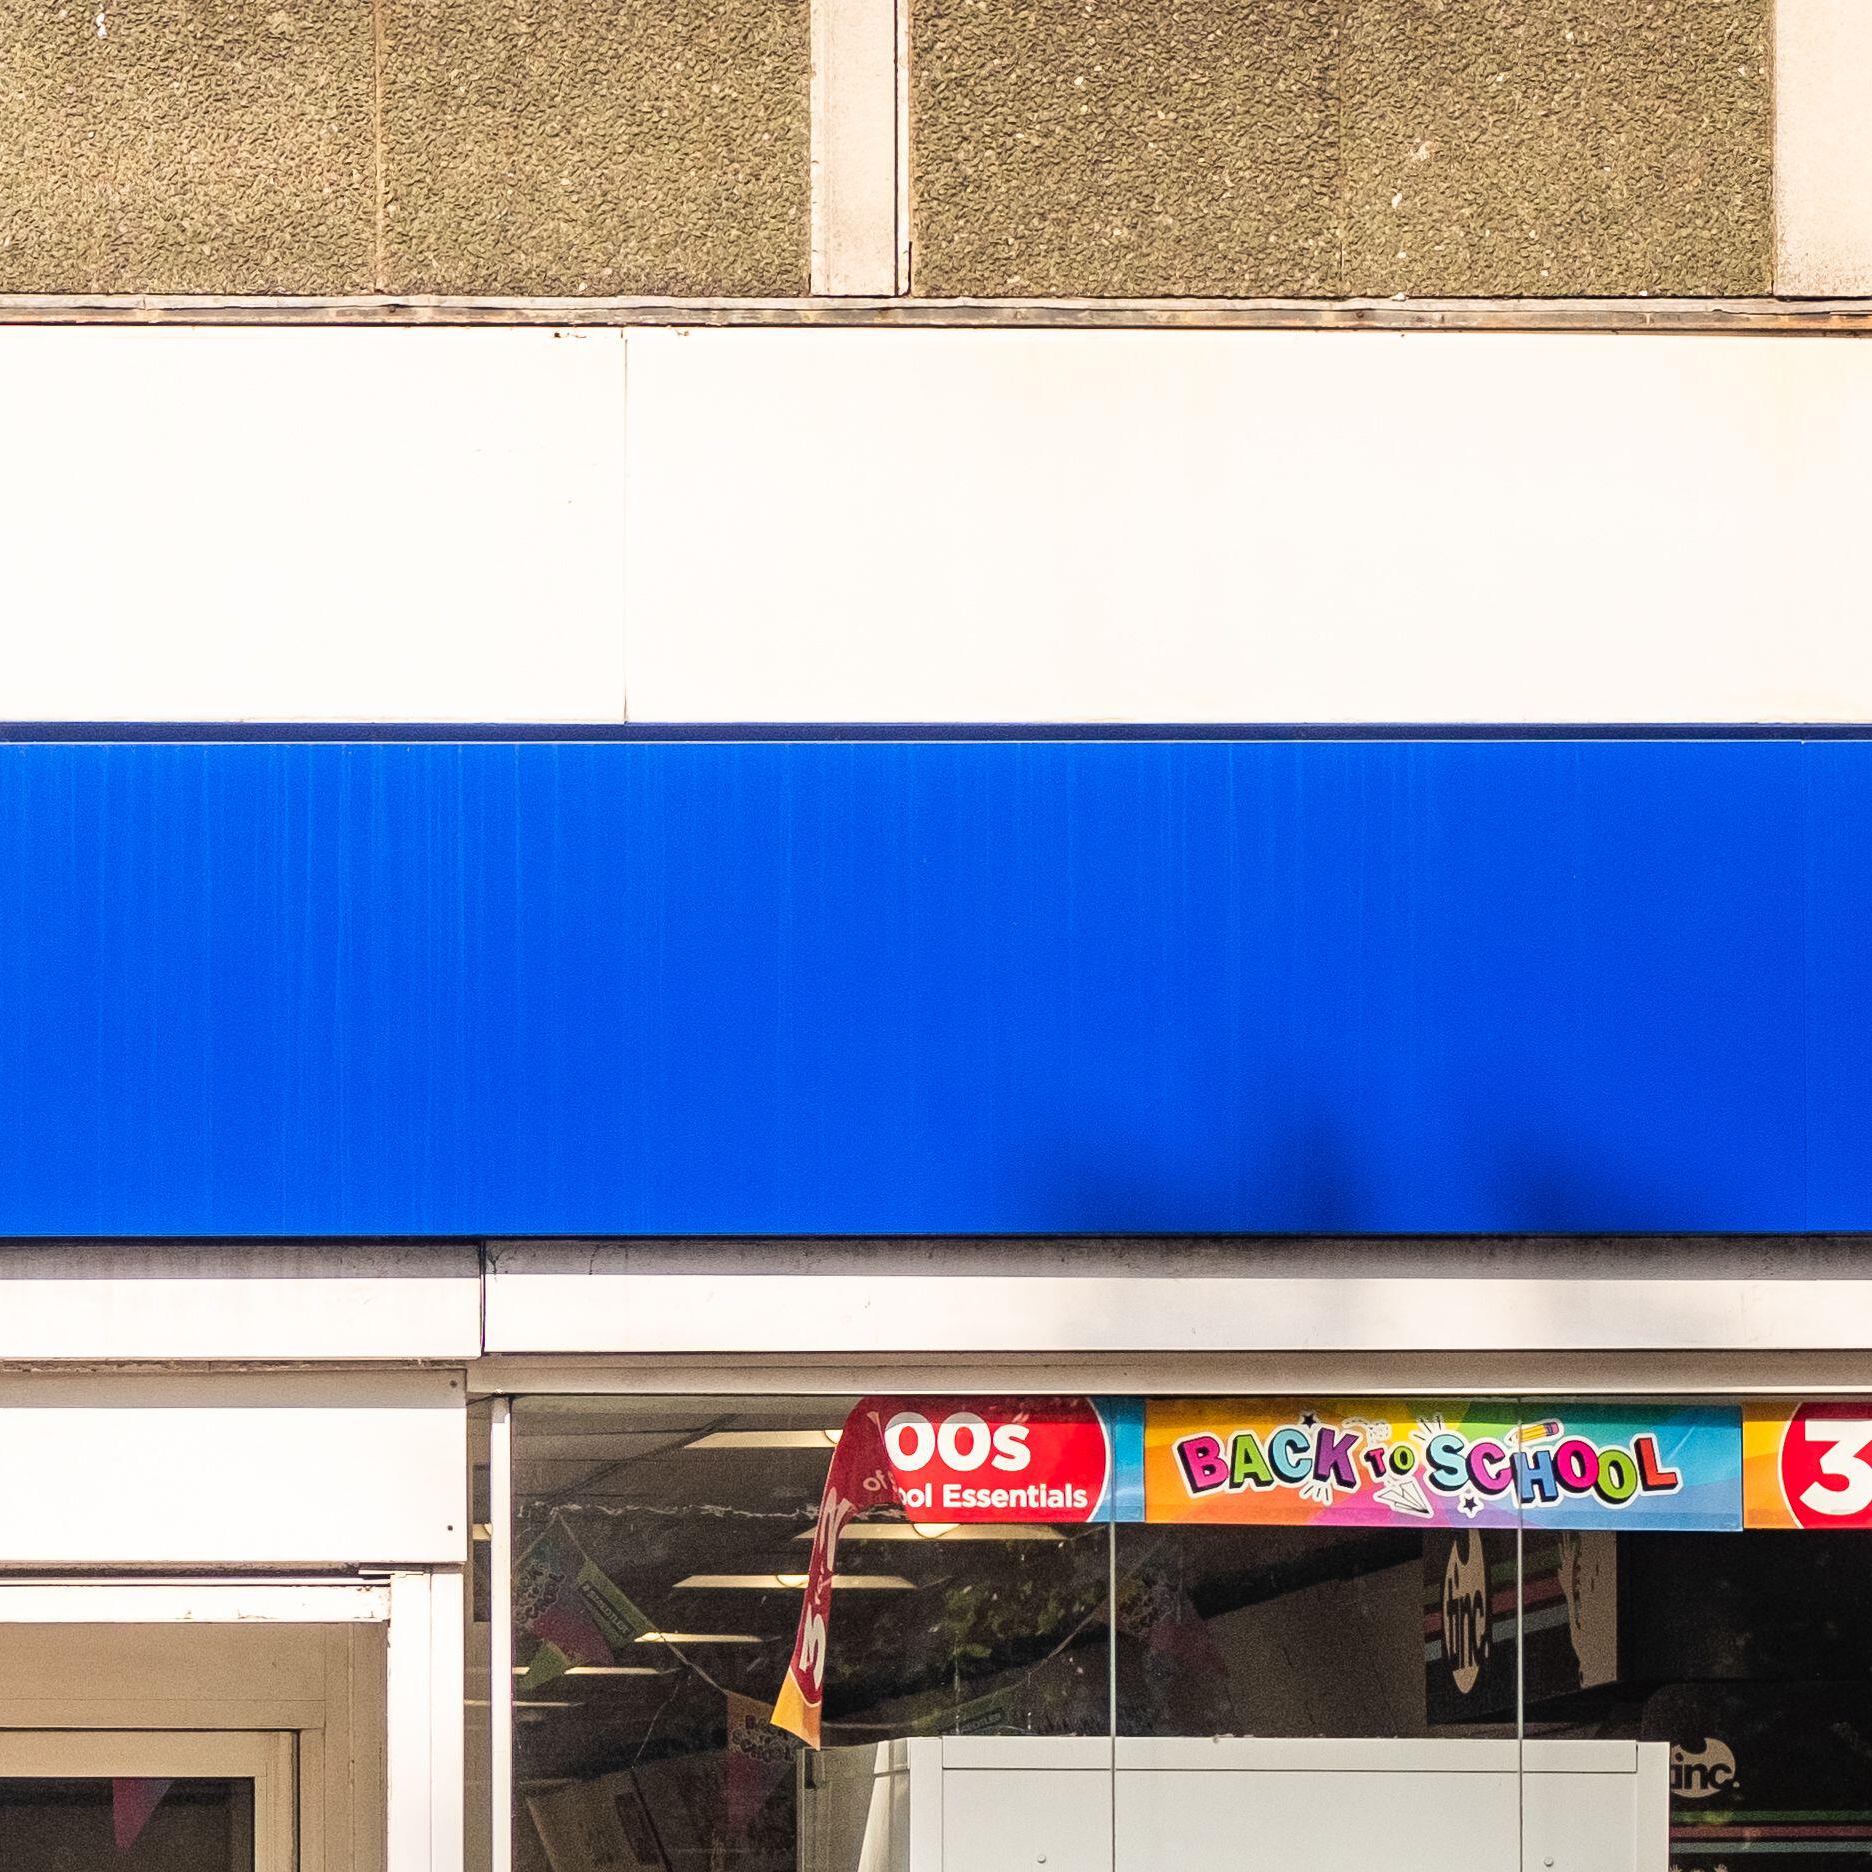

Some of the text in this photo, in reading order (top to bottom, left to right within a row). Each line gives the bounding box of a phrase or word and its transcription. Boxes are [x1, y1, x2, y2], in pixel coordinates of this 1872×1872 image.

[885, 1412, 1031, 1472] 00s
[1181, 1427, 1679, 1502] BACK TO SCHOOL
[1799, 1418, 1872, 1516] 3
[943, 1483, 1088, 1508] Essentials
[1671, 1752, 1741, 1790] inc.
